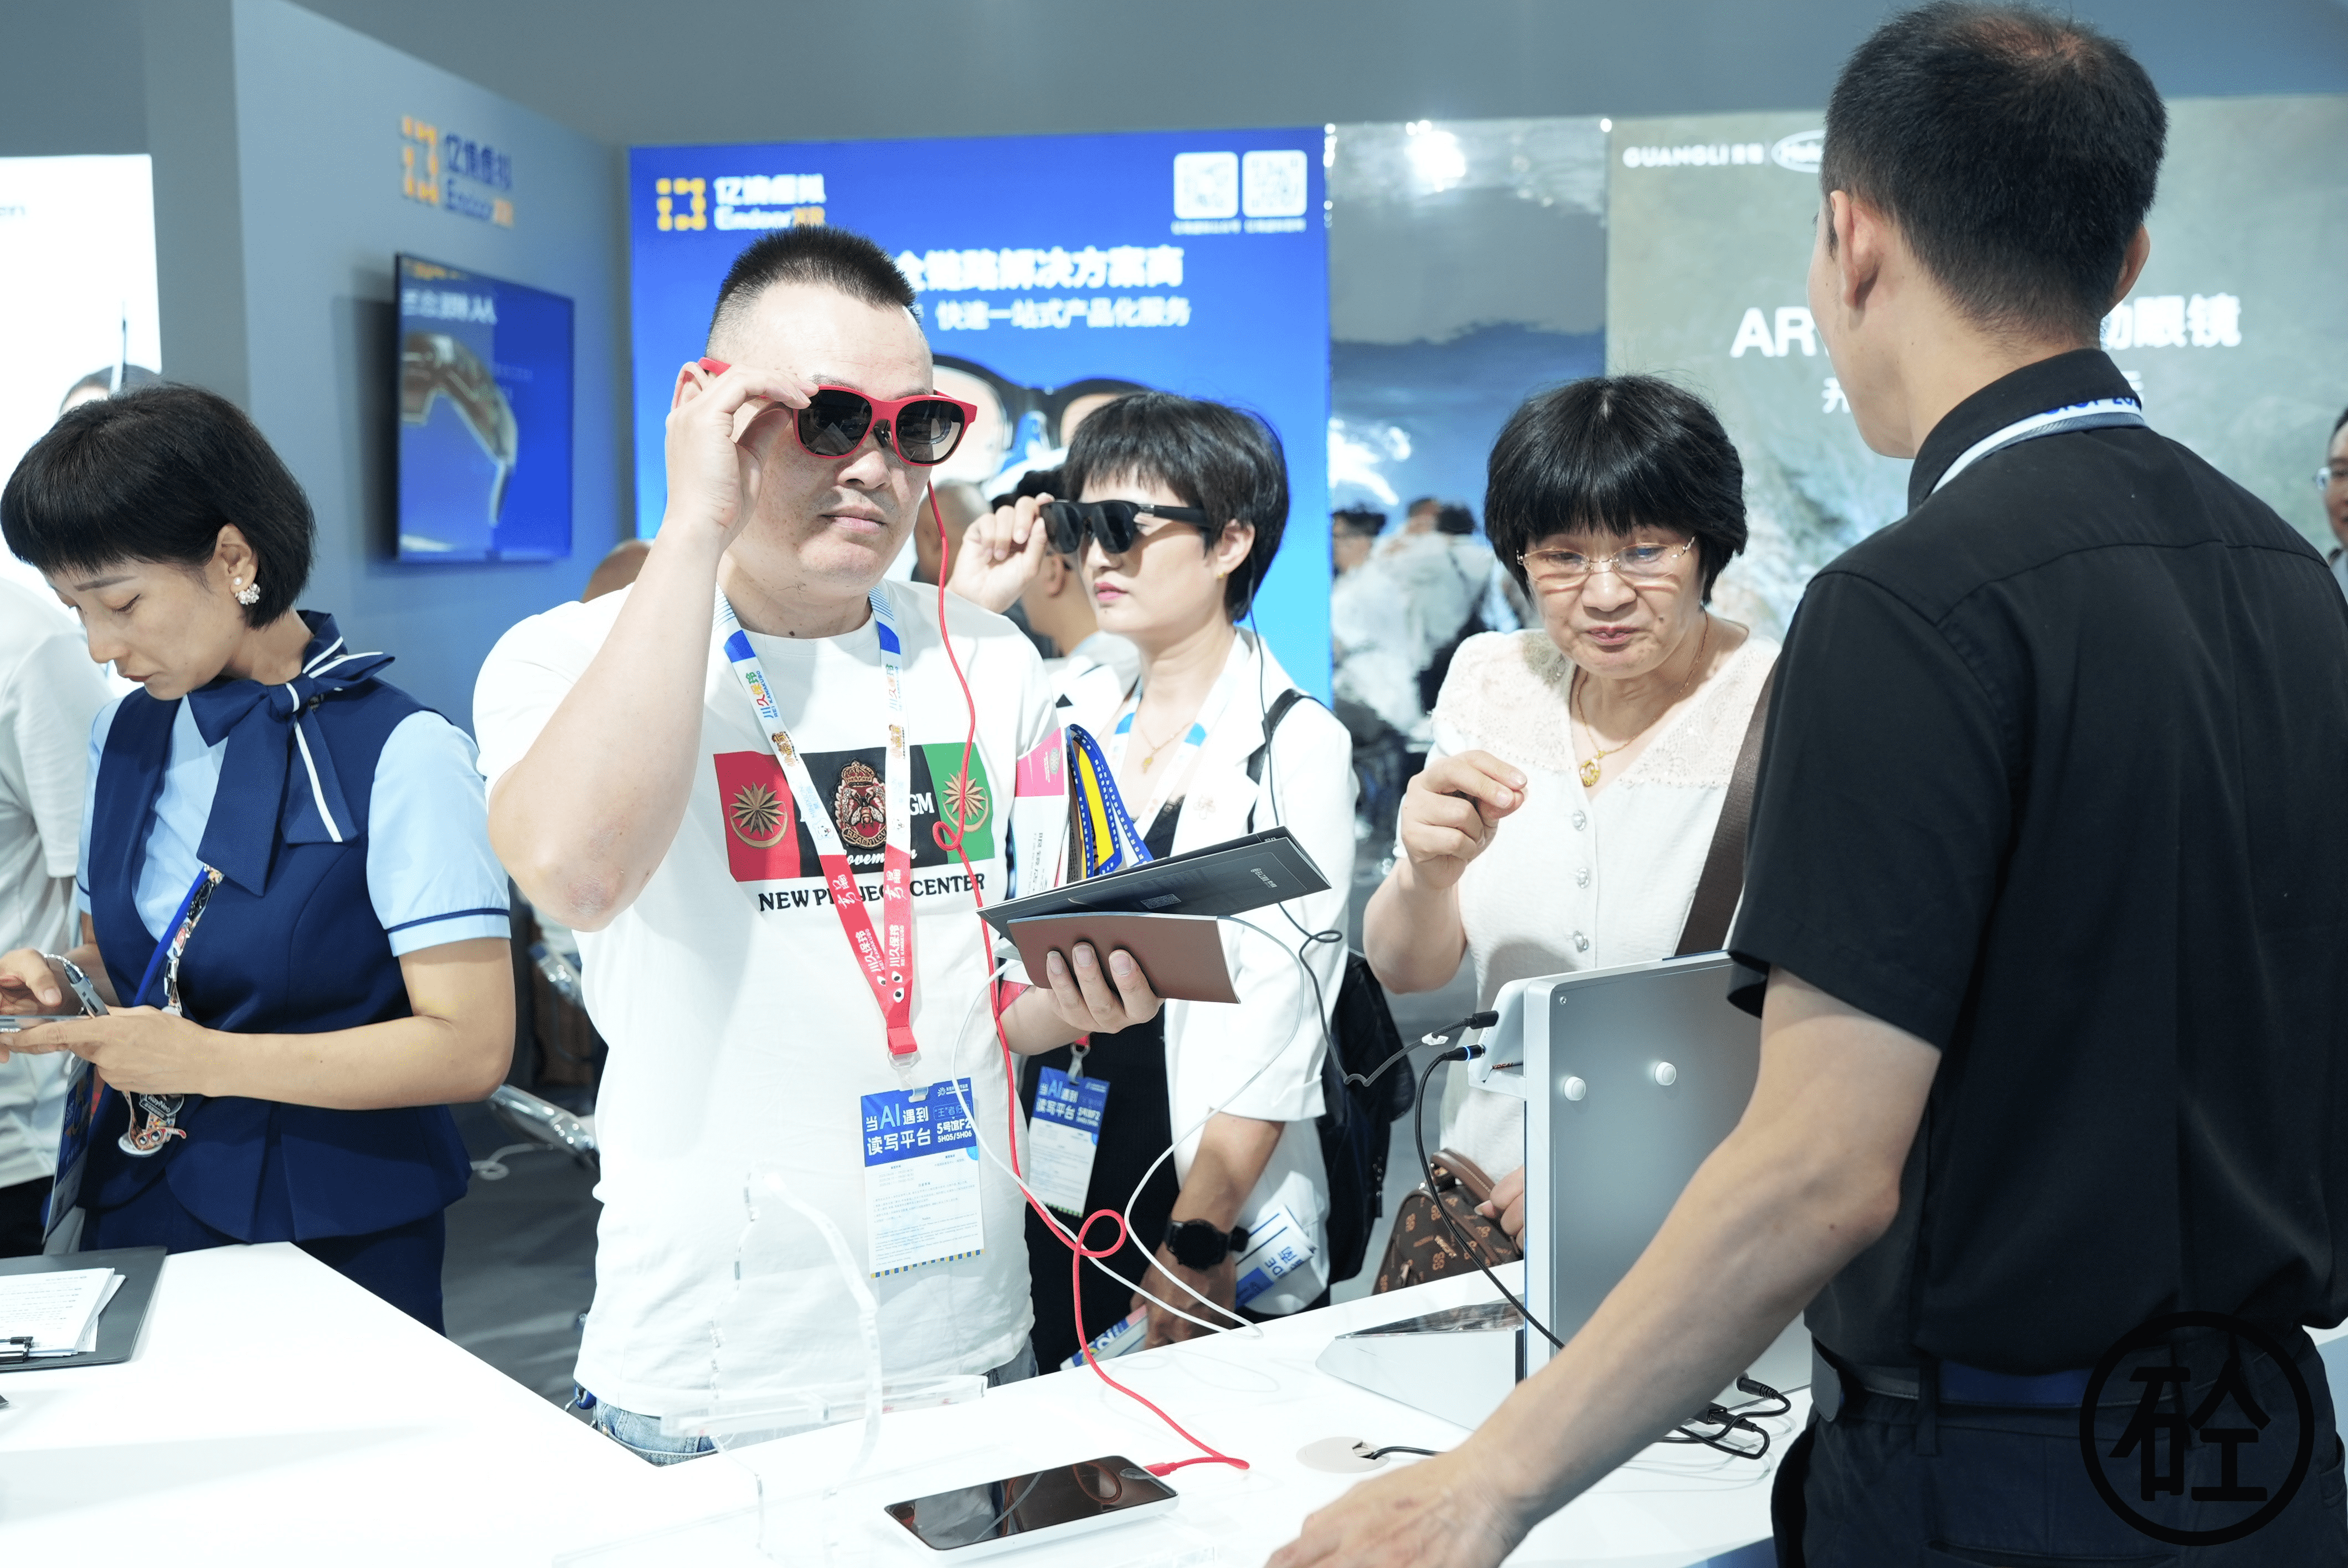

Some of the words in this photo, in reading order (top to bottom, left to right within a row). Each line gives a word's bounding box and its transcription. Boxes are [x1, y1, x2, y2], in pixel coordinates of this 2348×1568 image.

[758, 889, 810, 912] NEW
[909, 873, 985, 897] CENTER
[856, 930, 882, 972] 川久保玲
[889, 924, 900, 967] 川久保玲
[866, 1103, 929, 1133] 当AI遇到
[936, 1118, 972, 1134] 5号馆F2
[867, 1127, 931, 1156] 读写平台
[937, 1130, 972, 1143] 5H05/5H06
